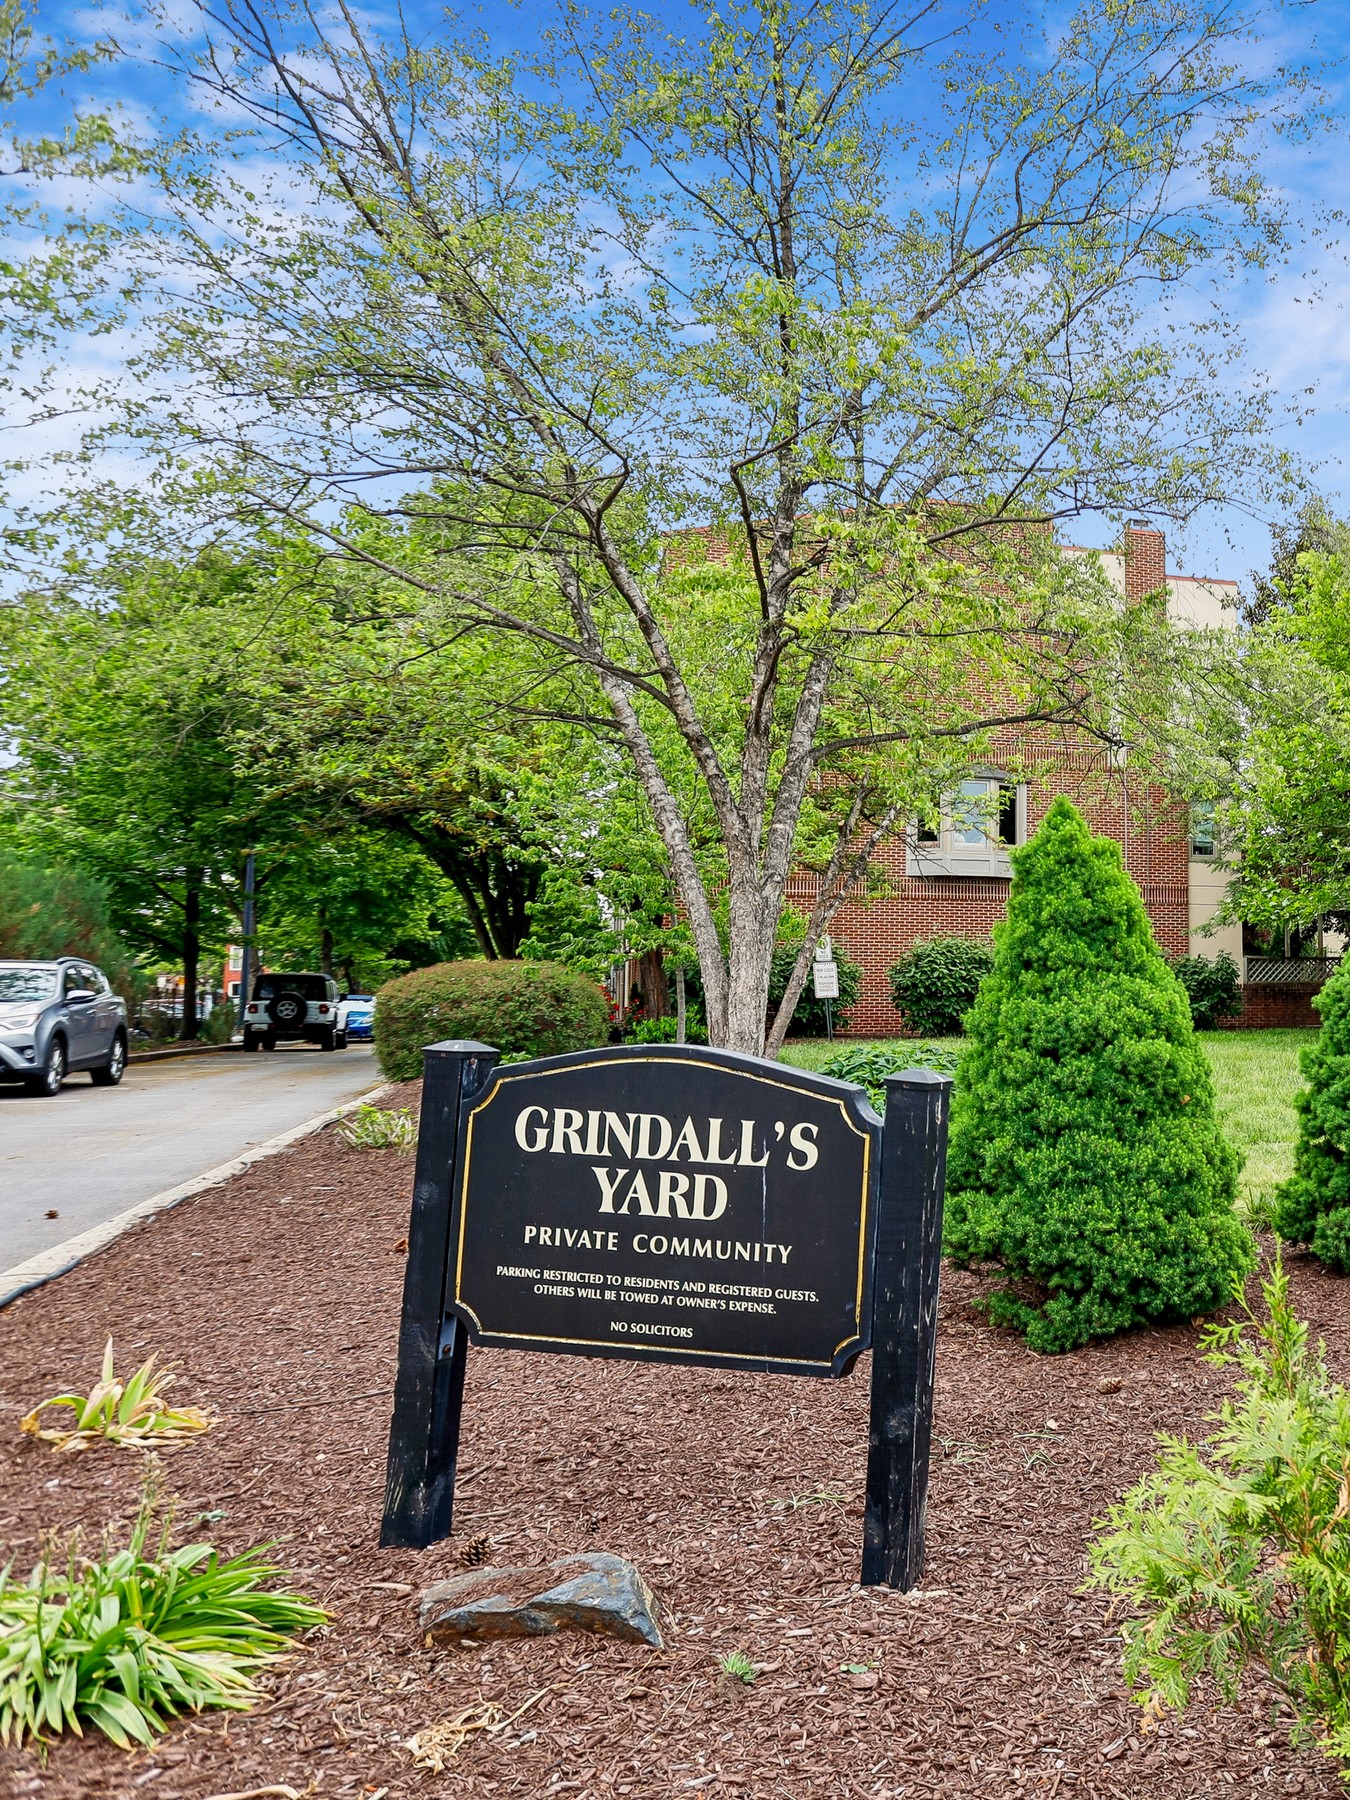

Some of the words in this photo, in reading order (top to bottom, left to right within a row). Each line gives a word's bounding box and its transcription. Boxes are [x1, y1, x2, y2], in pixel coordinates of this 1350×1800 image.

[515, 1106, 818, 1170] GRINDALL'S
[591, 1167, 728, 1220] YARD
[524, 1226, 618, 1250] PRIVATE
[633, 1234, 792, 1264] COMMUNITY
[497, 1266, 540, 1278] PARKING
[543, 1270, 603, 1283] RESTRICTED
[606, 1275, 621, 1285] TO
[624, 1277, 679, 1290] RESIDENTS
[682, 1282, 706, 1292] AND
[709, 1284, 772, 1297] REGISTERED
[775, 1289, 819, 1302] GUESTS.
[534, 1284, 574, 1296] OTHERS
[577, 1288, 601, 1299] WILL
[605, 1290, 616, 1300] BE
[619, 1291, 658, 1303] TOWED
[661, 1295, 674, 1305] AT
[677, 1297, 726, 1309] OWNER'S
[729, 1301, 776, 1314] EXPENSE.
[611, 1322, 628, 1332] NO
[630, 1323, 693, 1338] SOLICITORS
